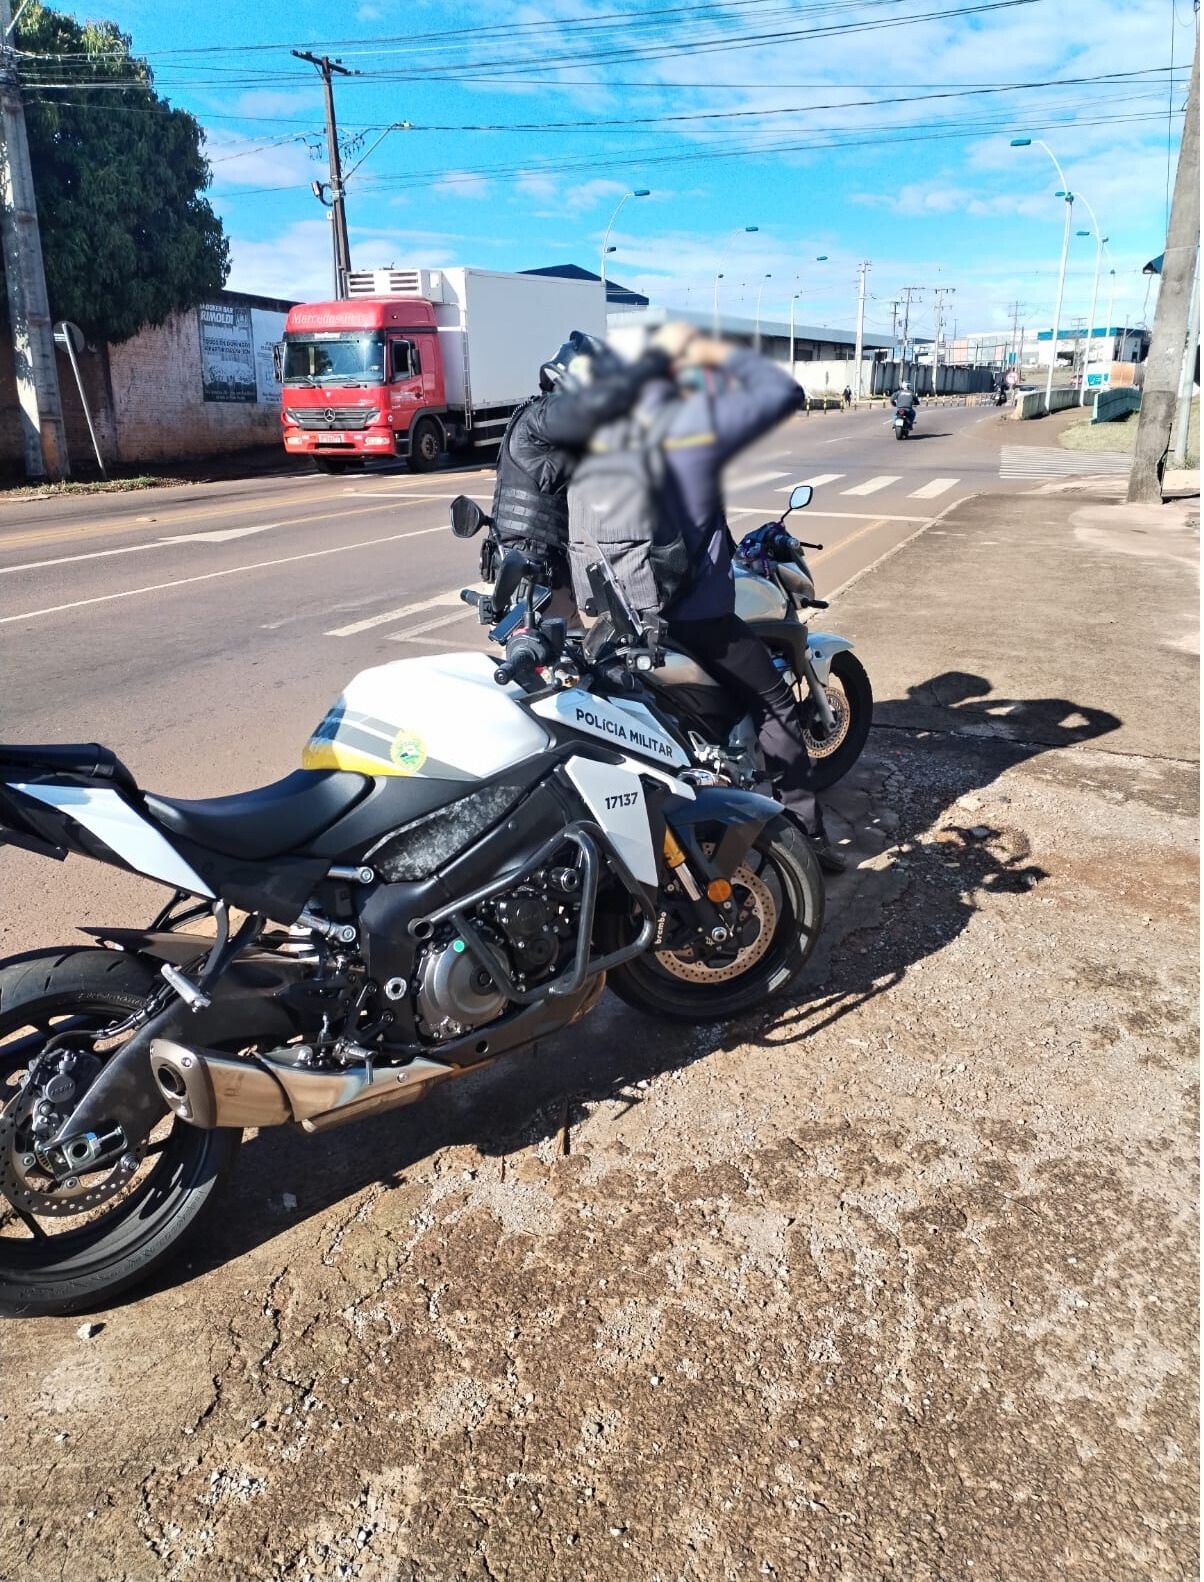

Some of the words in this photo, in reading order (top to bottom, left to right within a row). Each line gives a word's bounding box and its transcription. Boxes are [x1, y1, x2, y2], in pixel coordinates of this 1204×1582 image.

[200, 310, 234, 325] RIMOLDI
[629, 729, 673, 758] MILITAR
[604, 791, 638, 810] 17137
[653, 911, 667, 945] brembo
